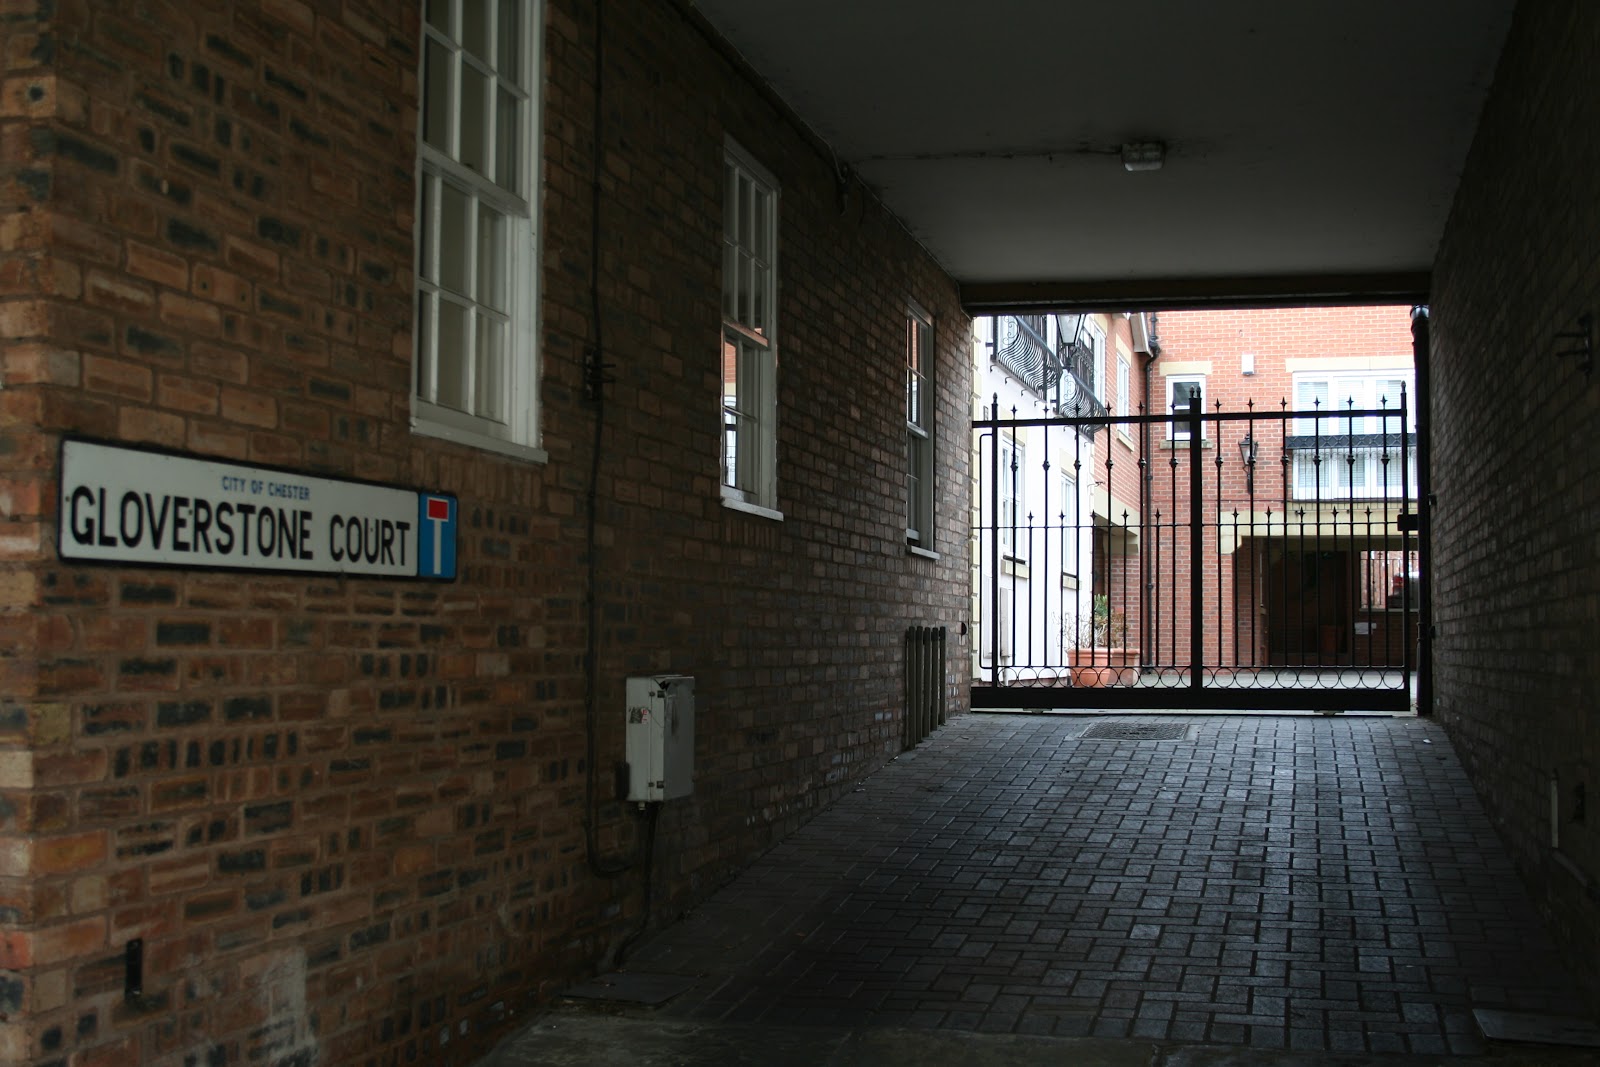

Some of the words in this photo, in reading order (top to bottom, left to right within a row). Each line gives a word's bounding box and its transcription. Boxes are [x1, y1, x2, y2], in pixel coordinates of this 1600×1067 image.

[222, 476, 246, 492] CITY
[251, 481, 264, 495] OF
[268, 482, 310, 500] CHESTER
[71, 485, 314, 560] GLOVERSTONE
[329, 514, 411, 566] COURT
